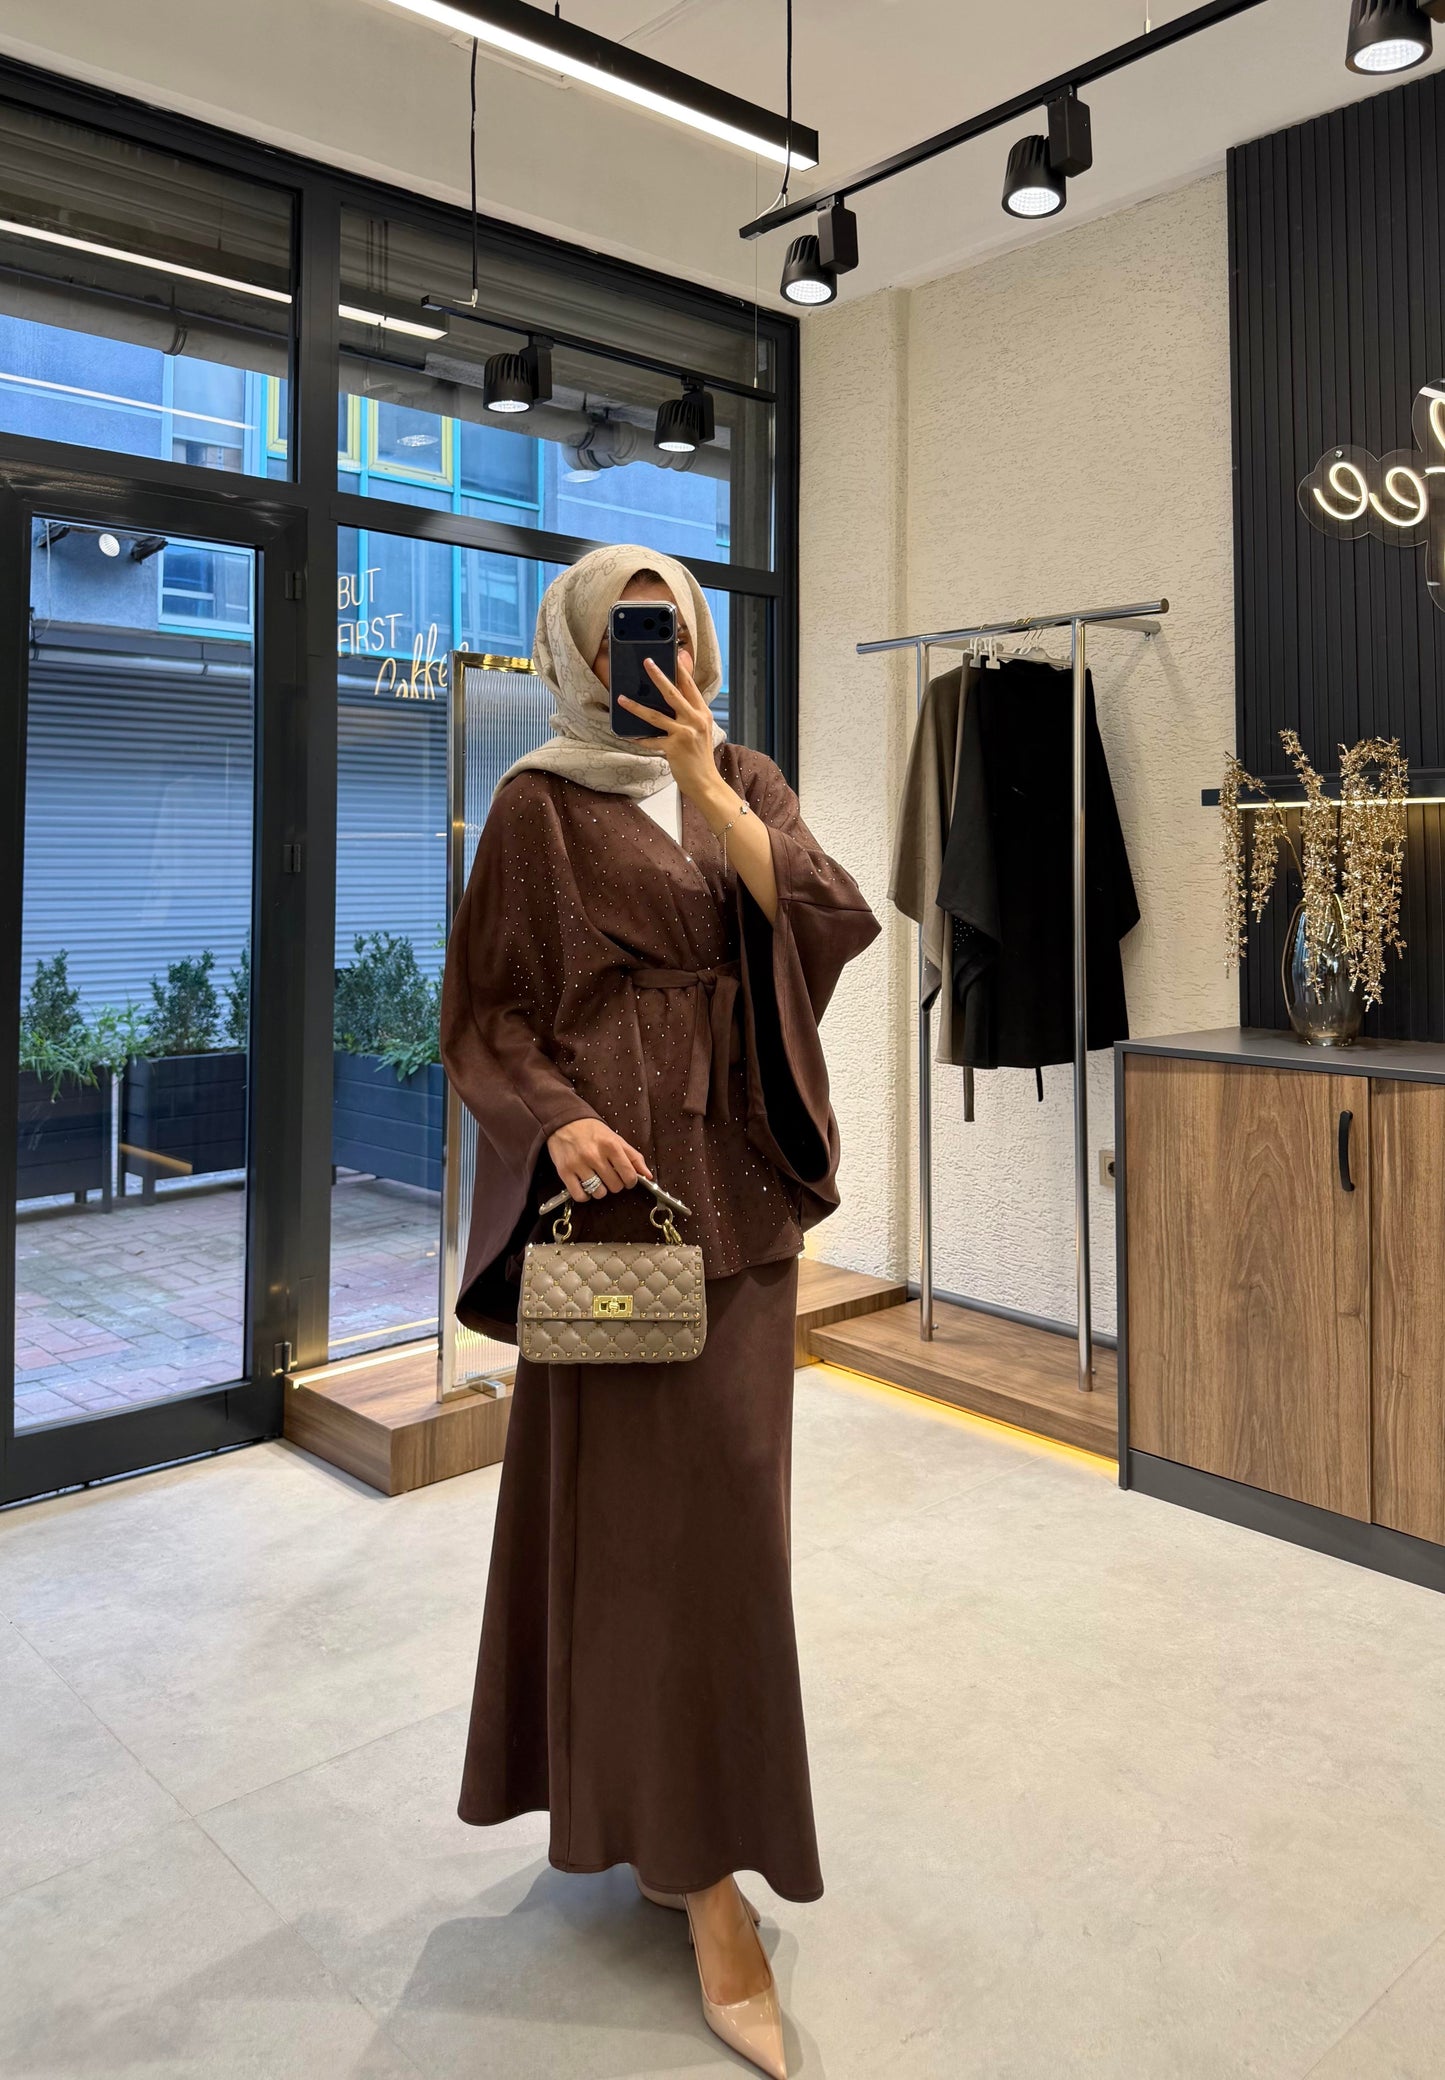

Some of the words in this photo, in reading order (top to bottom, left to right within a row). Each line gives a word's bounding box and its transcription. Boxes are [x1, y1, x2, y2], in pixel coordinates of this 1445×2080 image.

[337, 567, 382, 610] BUT
[337, 613, 404, 657] FIRST
[374, 622, 469, 700] Coffe
